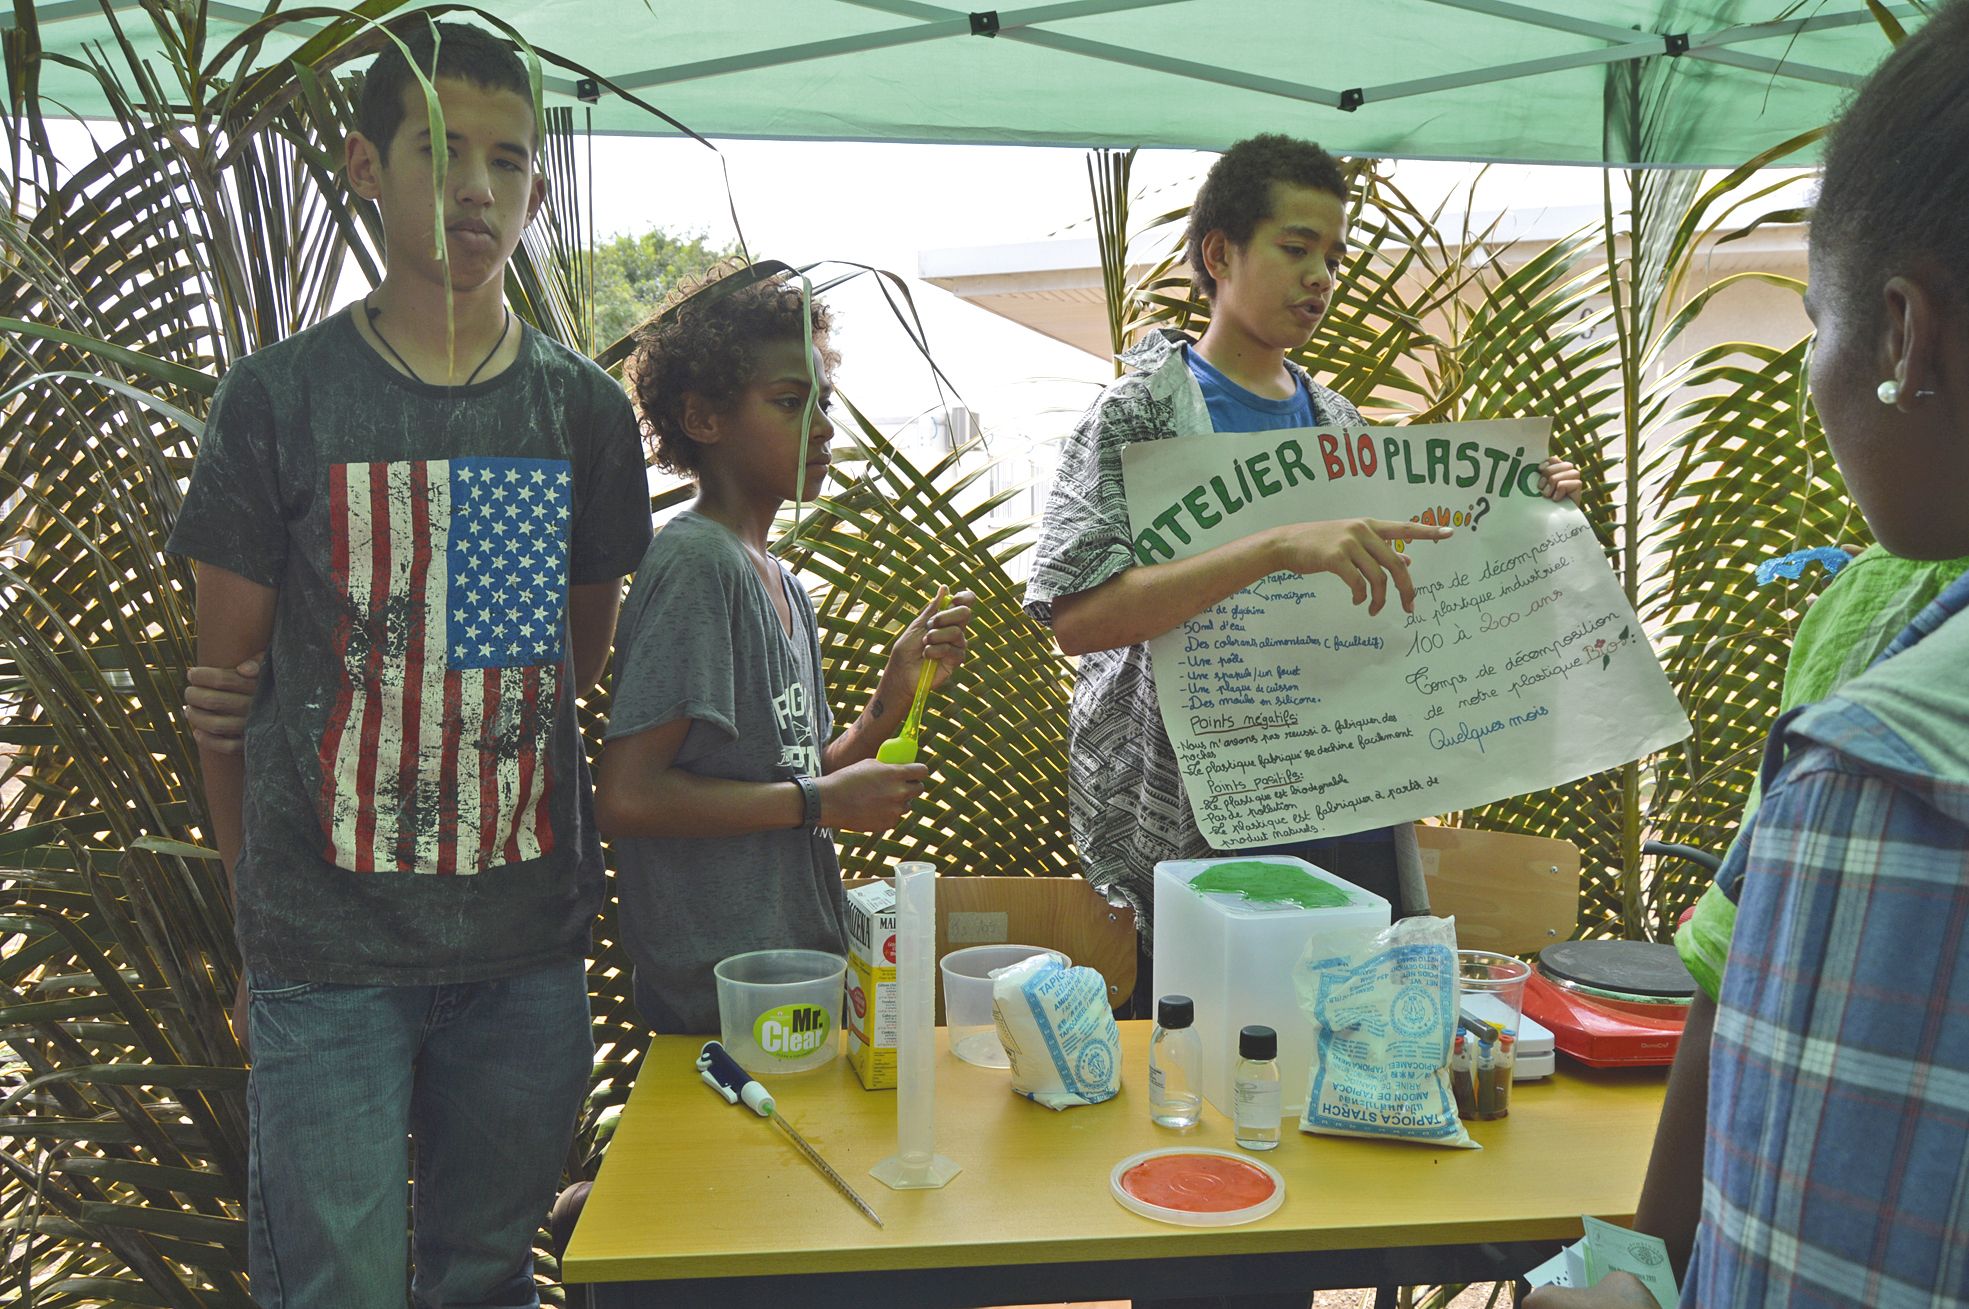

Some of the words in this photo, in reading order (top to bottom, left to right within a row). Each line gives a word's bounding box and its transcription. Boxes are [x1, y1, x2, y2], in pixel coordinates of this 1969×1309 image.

[1449, 571, 1470, 589] de
[1478, 524, 1592, 582] décomposition
[1216, 605, 1228, 615] de
[1404, 612, 1427, 629] du
[1432, 591, 1496, 626] plastique
[1405, 630, 1444, 657] 100
[1453, 623, 1472, 645] à
[1480, 612, 1521, 633] 200
[1525, 589, 1564, 617] ans
[1405, 666, 1468, 695] Temps
[1475, 664, 1498, 679] de
[1505, 612, 1621, 671] décomposition
[1215, 680, 1252, 697] plaque
[1255, 684, 1265, 693] de
[1266, 683, 1299, 693] cuisson
[1424, 705, 1445, 721] de
[1458, 689, 1499, 709] notre
[1508, 656, 1582, 699] plastique
[1190, 713, 1235, 735] Points
[1261, 733, 1280, 744] pas
[1320, 724, 1331, 733] à
[1382, 713, 1398, 724] des
[1428, 719, 1505, 754] Quelques
[1508, 705, 1550, 727] mois
[1205, 760, 1257, 780] plastique
[1357, 728, 1414, 750] facilement
[1207, 779, 1247, 795] Points
[1274, 790, 1289, 800] est
[1228, 810, 1242, 820] de
[1248, 802, 1298, 818] pollution
[1233, 817, 1288, 834] plastique
[1293, 810, 1311, 824] est
[1375, 790, 1385, 800] à
[1427, 776, 1440, 788] de
[1220, 832, 1269, 848] produit
[792, 1008, 823, 1033] Mr.
[762, 1021, 823, 1052] Clear
[1331, 1082, 1374, 1098] TAPIOCA
[1377, 1092, 1392, 1101] DE
[1322, 1103, 1377, 1122] STARCH
[1381, 1113, 1441, 1127] TAPIOCA
